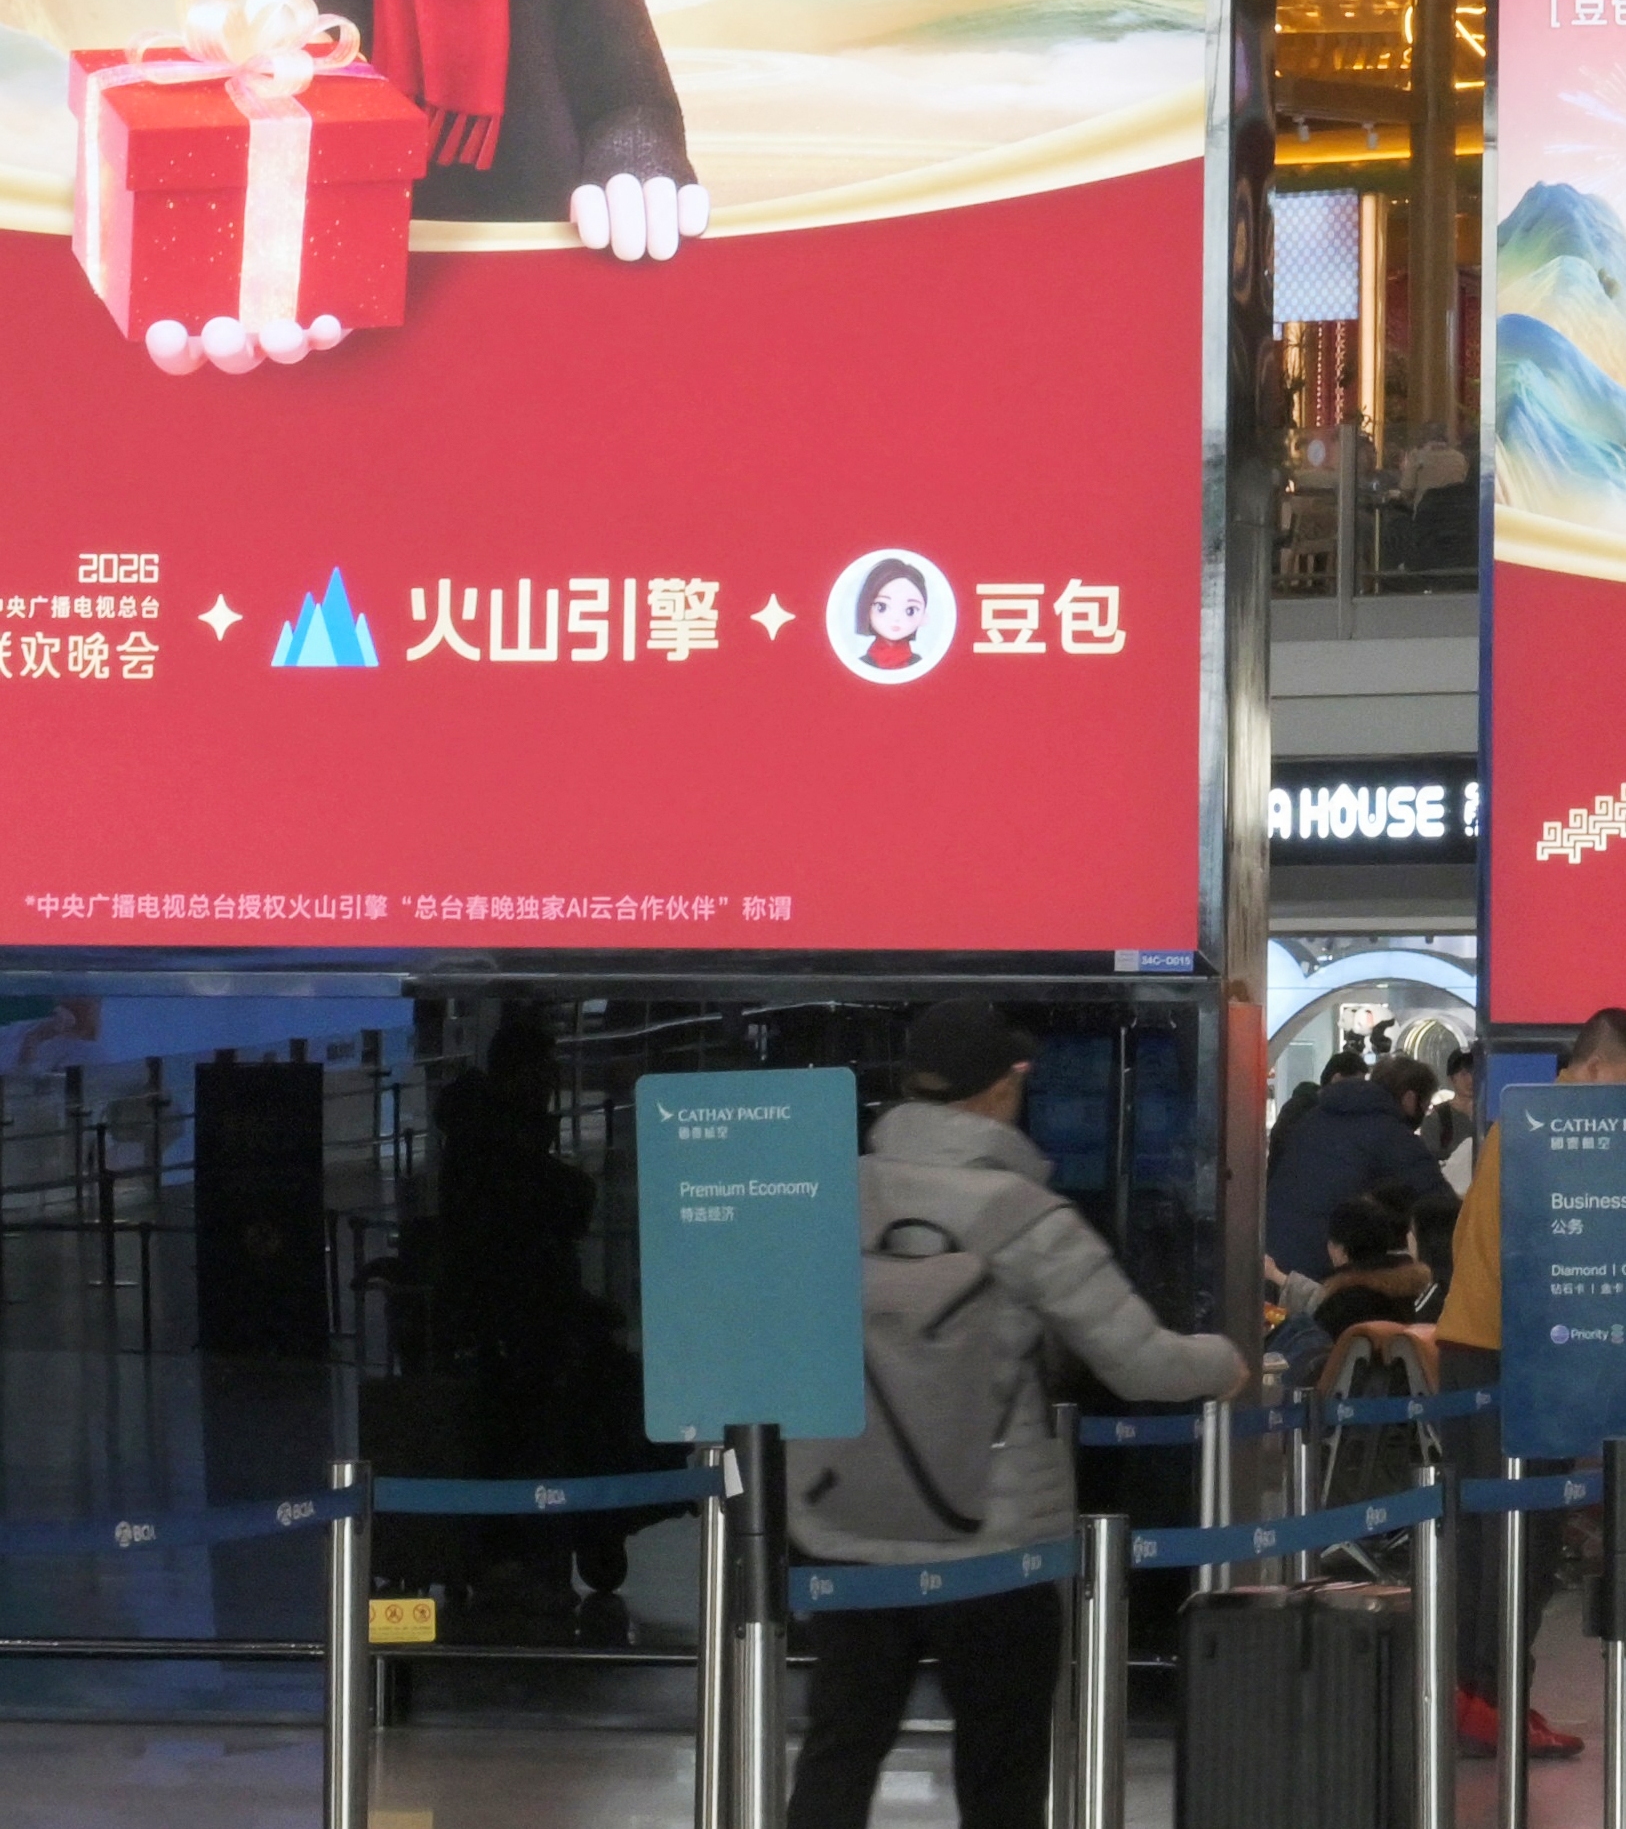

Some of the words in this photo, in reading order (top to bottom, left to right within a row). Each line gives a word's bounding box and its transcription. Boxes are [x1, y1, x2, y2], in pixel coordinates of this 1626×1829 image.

[79, 554, 159, 583] 2026
[407, 578, 719, 661] 火山引擎
[973, 579, 1125, 654] 豆包
[1300, 783, 1444, 839] HOUSE
[678, 1108, 734, 1122] CATHAY
[737, 1106, 791, 1119] PACIFIC
[1550, 1118, 1618, 1132] CATHAY
[680, 1182, 745, 1198] Premium
[749, 1180, 818, 1198] Economy
[1550, 1218, 1584, 1235] 公务
[1551, 1263, 1607, 1277] Diamond
